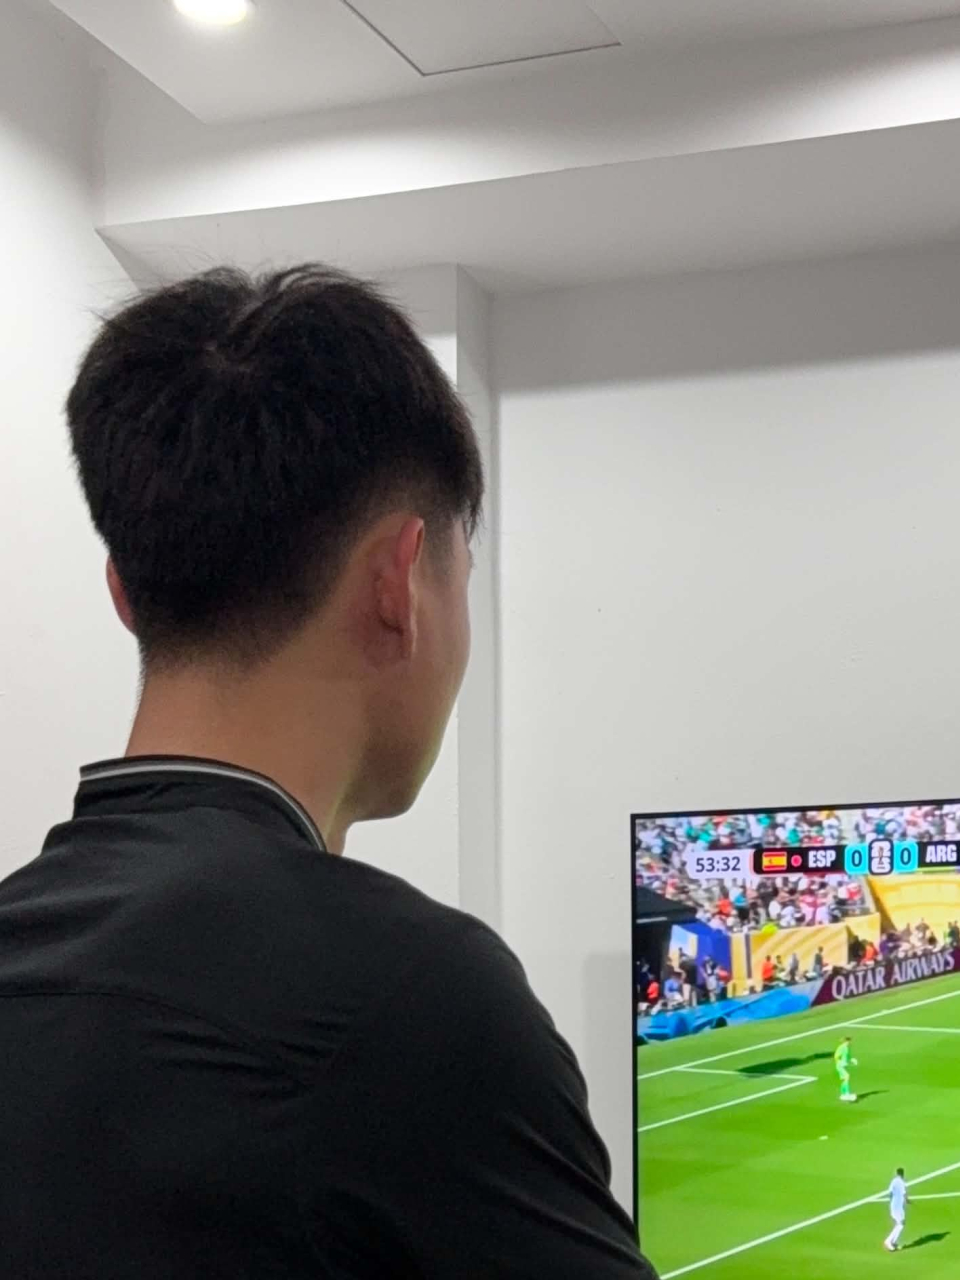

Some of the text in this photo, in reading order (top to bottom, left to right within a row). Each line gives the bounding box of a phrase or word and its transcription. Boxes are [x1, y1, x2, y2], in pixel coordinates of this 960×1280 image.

[695, 844, 958, 873] 53:32 ESP 0 0 ARG
[831, 950, 956, 1000] QATAR AIRWAYS
